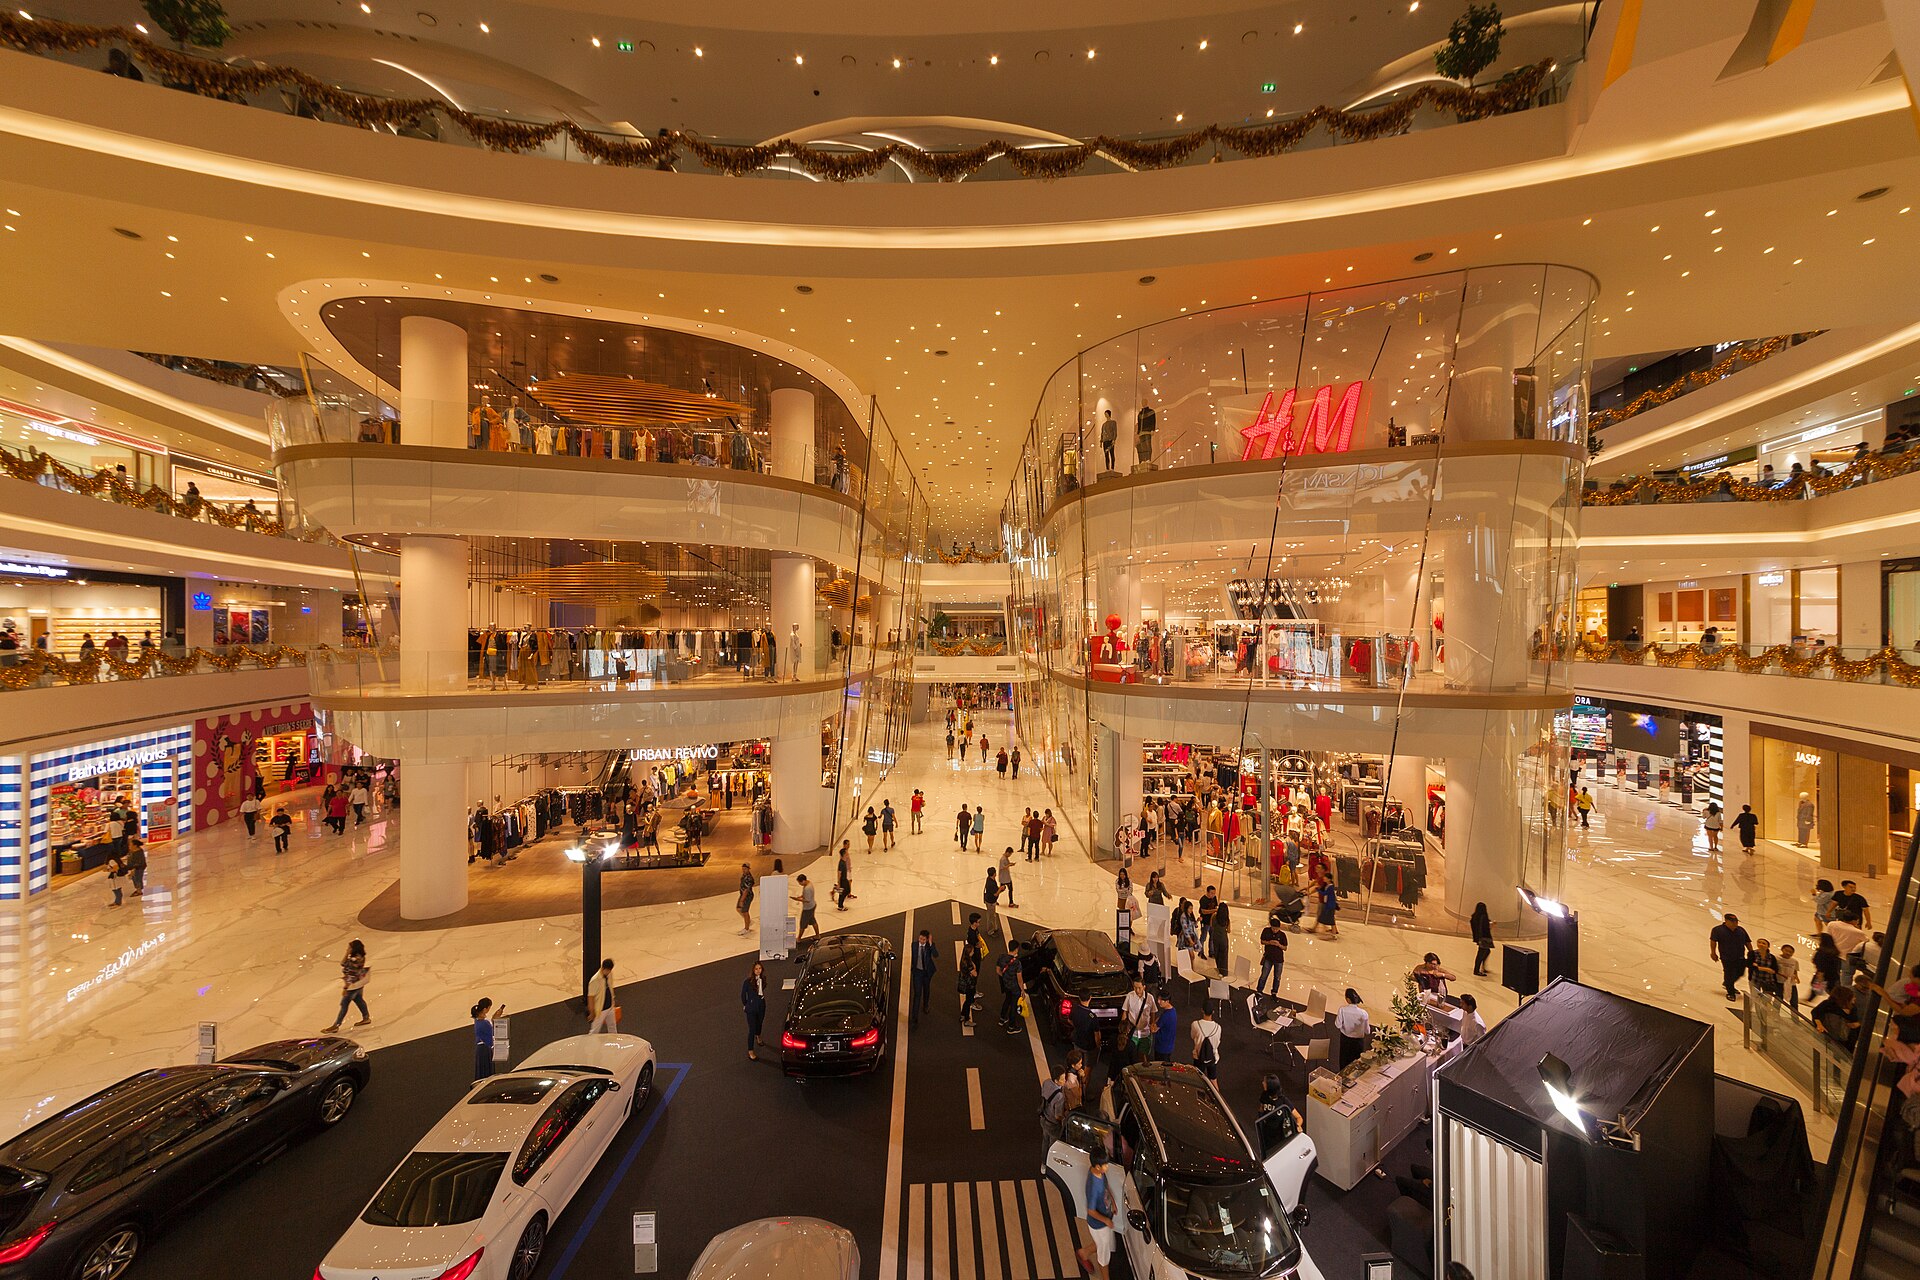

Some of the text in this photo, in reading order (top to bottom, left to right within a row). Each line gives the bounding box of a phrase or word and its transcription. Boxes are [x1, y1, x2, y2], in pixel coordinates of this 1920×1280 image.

[1240, 380, 1363, 461] H&M
[68, 749, 168, 781] Bath & Body Works
[630, 746, 718, 761] URBAN REVIVO
